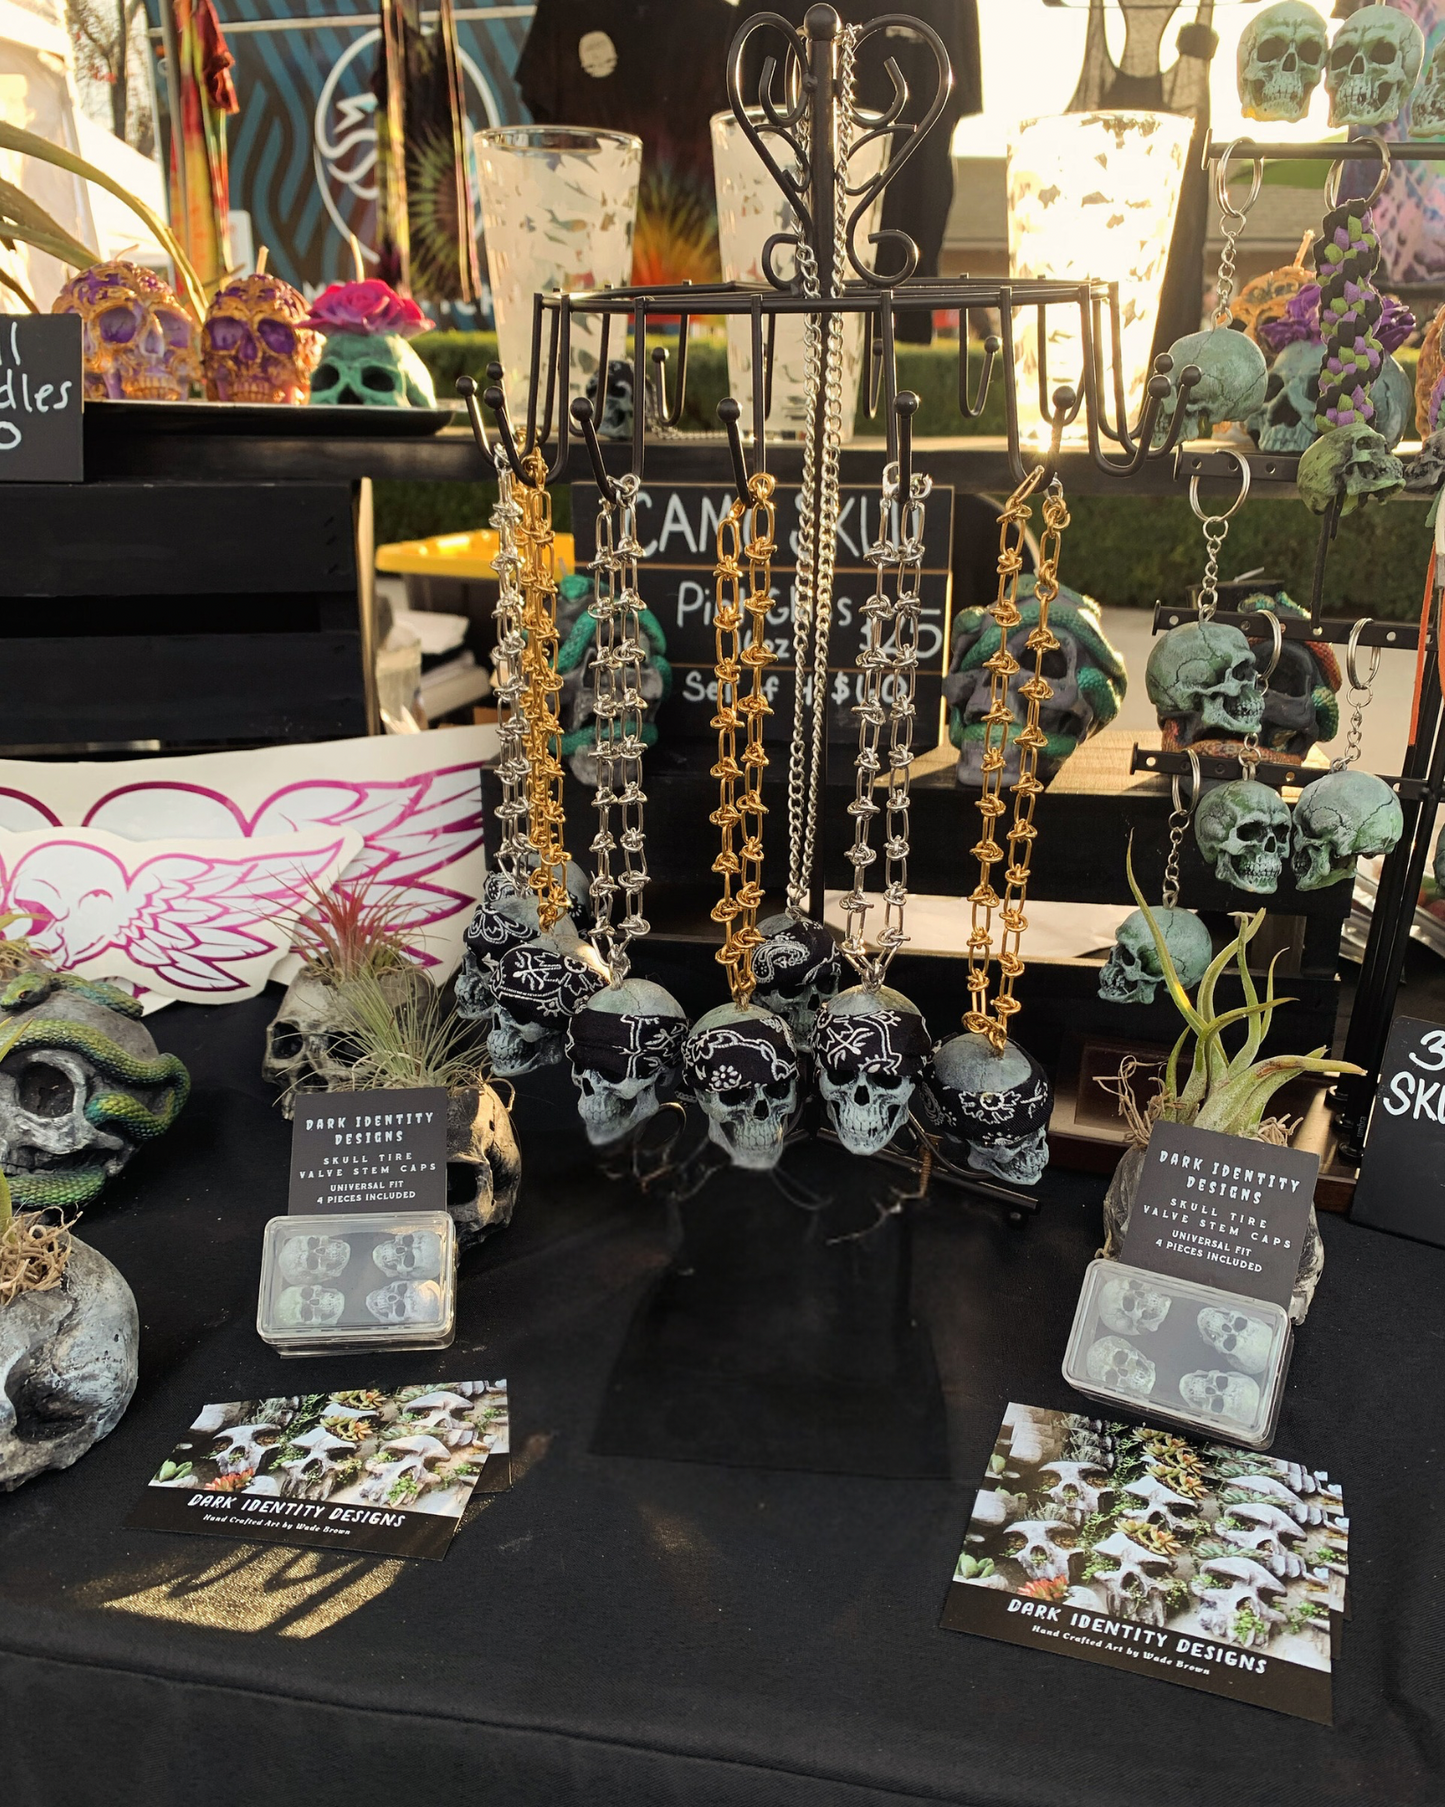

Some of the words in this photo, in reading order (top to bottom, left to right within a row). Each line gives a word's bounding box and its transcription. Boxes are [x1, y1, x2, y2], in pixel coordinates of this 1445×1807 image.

[306, 1117, 346, 1131] DARK
[355, 1112, 434, 1128] IDENTITY
[335, 1130, 403, 1145] DESIGNS
[300, 1168, 344, 1179] VALVE
[353, 1166, 390, 1175] STEM
[400, 1163, 436, 1172] CAPS
[323, 1156, 368, 1165] SKULL
[379, 1152, 413, 1162] TIRE
[1159, 1150, 1203, 1171] DARK
[1212, 1162, 1300, 1193] IDENTITY
[316, 1196, 323, 1204] 4
[327, 1194, 362, 1204] PIECES
[365, 1191, 416, 1201] INCLUDED
[330, 1182, 385, 1192] UNIVERSAL
[389, 1180, 404, 1189] FIT
[1186, 1175, 1262, 1205] DESIGNS
[1143, 1204, 1189, 1224] VALVE
[1199, 1219, 1240, 1236] STEM
[1250, 1232, 1291, 1249] CAPS
[1170, 1197, 1218, 1217] SKULL
[1230, 1212, 1268, 1229] TIRE
[1155, 1238, 1163, 1247] 4
[1166, 1241, 1203, 1258] PIECES
[1206, 1252, 1263, 1273] INCLUDED
[1171, 1229, 1230, 1252] UNIVERSAL
[1235, 1245, 1252, 1257] FIT
[187, 1494, 237, 1509] DARK
[241, 1498, 325, 1518] IDENTITY
[328, 1507, 406, 1528] DESIGNS
[203, 1513, 227, 1522] Hand
[229, 1516, 264, 1527] Crafted
[264, 1519, 280, 1528] Art
[282, 1521, 293, 1530] by
[296, 1522, 321, 1533] Wade
[323, 1526, 351, 1535] Brown
[1006, 1598, 1062, 1622] DARK
[1070, 1612, 1168, 1648] IDENTITY
[1176, 1638, 1267, 1675] DESIGNS
[1031, 1625, 1060, 1638] Hand
[1062, 1632, 1103, 1649] Crafted
[1104, 1641, 1123, 1653] Art
[1126, 1646, 1140, 1659] by
[1142, 1651, 1173, 1666] Wade
[1175, 1659, 1210, 1675] Brown
